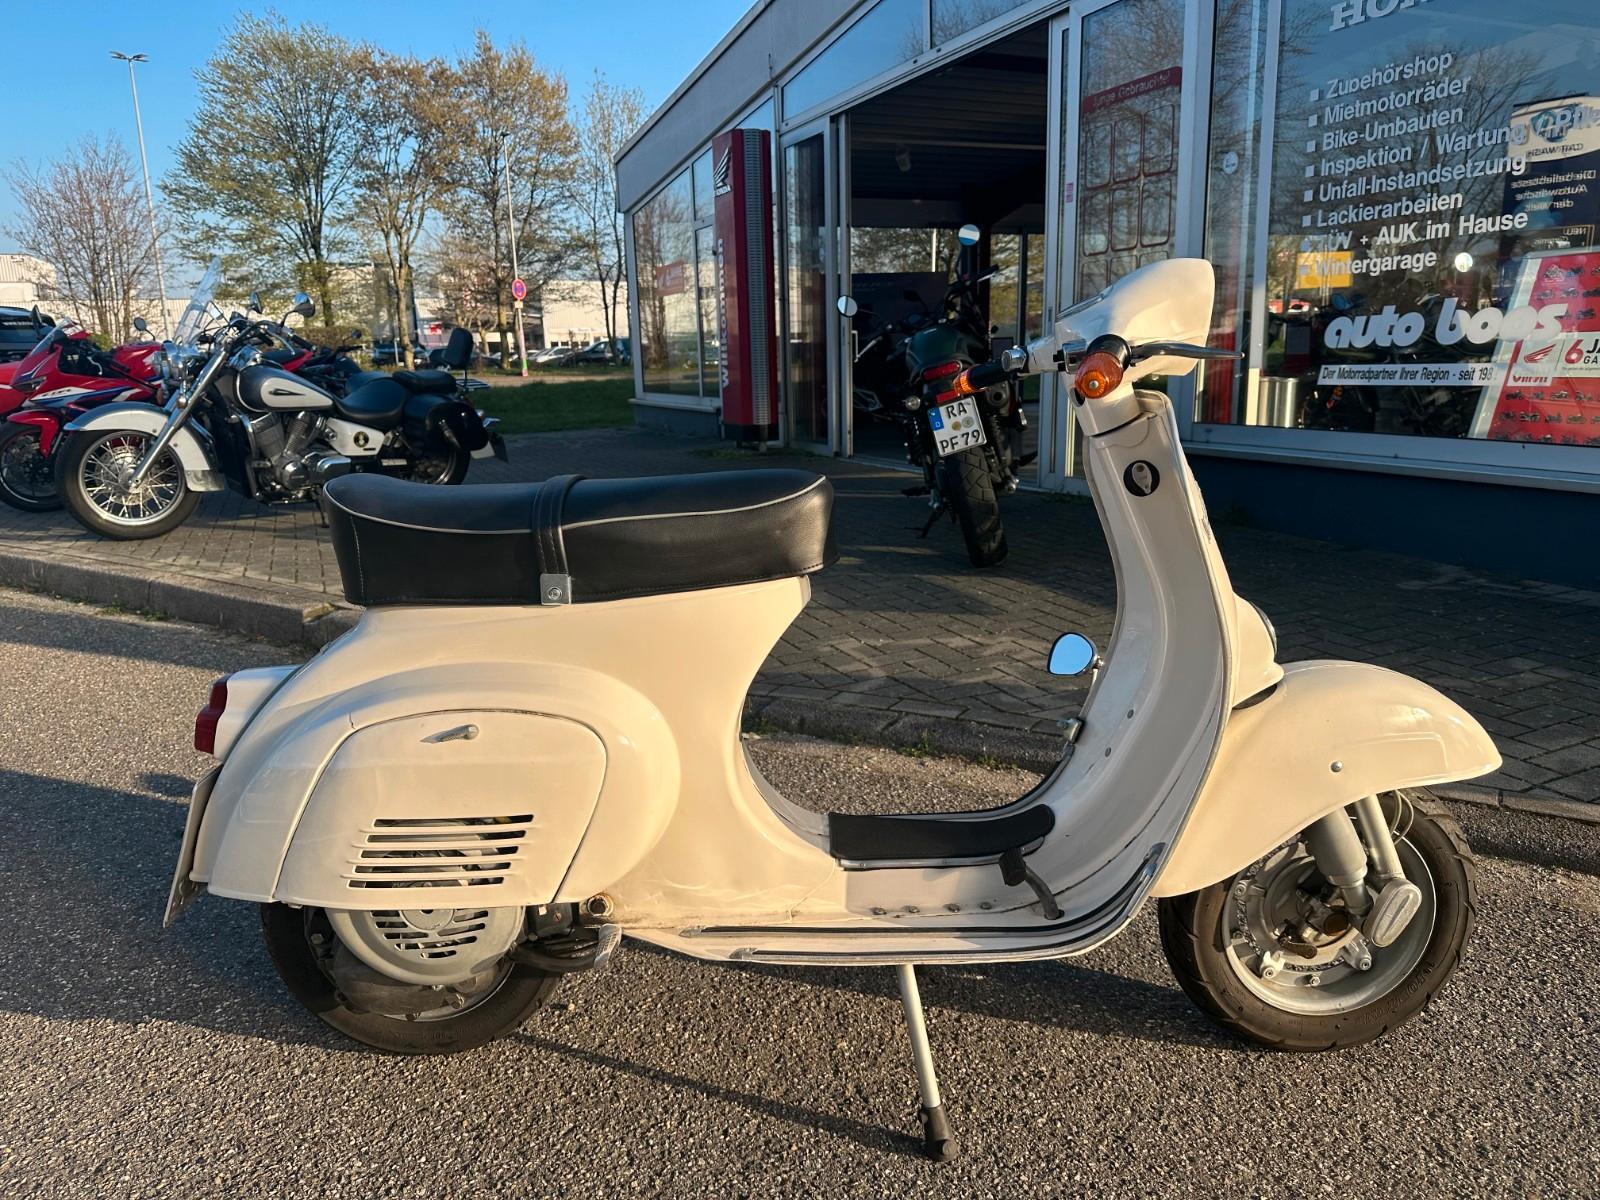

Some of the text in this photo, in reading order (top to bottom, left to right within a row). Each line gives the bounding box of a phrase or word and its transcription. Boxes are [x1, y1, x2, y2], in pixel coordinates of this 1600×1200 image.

[1329, 0, 1433, 31] HO
[1326, 51, 1453, 100] Zubehörshop
[1324, 75, 1471, 125] Mietmotorräder
[1323, 105, 1463, 150] Bike-Umbauten
[1320, 145, 1411, 179] Inspektion
[1420, 140, 1429, 158] /
[1438, 123, 1527, 156] Wartung
[1319, 155, 1527, 201] Unfall-Instandsetzung
[1317, 192, 1463, 226] Lackierarbeiten
[1376, 221, 1418, 246] AUK
[1426, 220, 1450, 239] im
[1459, 211, 1528, 236] Hause
[1316, 250, 1437, 276] Wintergarage
[1324, 297, 1568, 349] auto boos
[1565, 339, 1584, 364] 6
[1322, 367, 1335, 380] Der
[1337, 367, 1397, 383] Motorradpartner
[1399, 367, 1418, 380] Ihrer
[1421, 367, 1449, 383] Region
[1458, 367, 1475, 380] seit
[1478, 366, 1498, 380] 198
[946, 402, 967, 419] RA
[940, 429, 981, 453] PF 79
